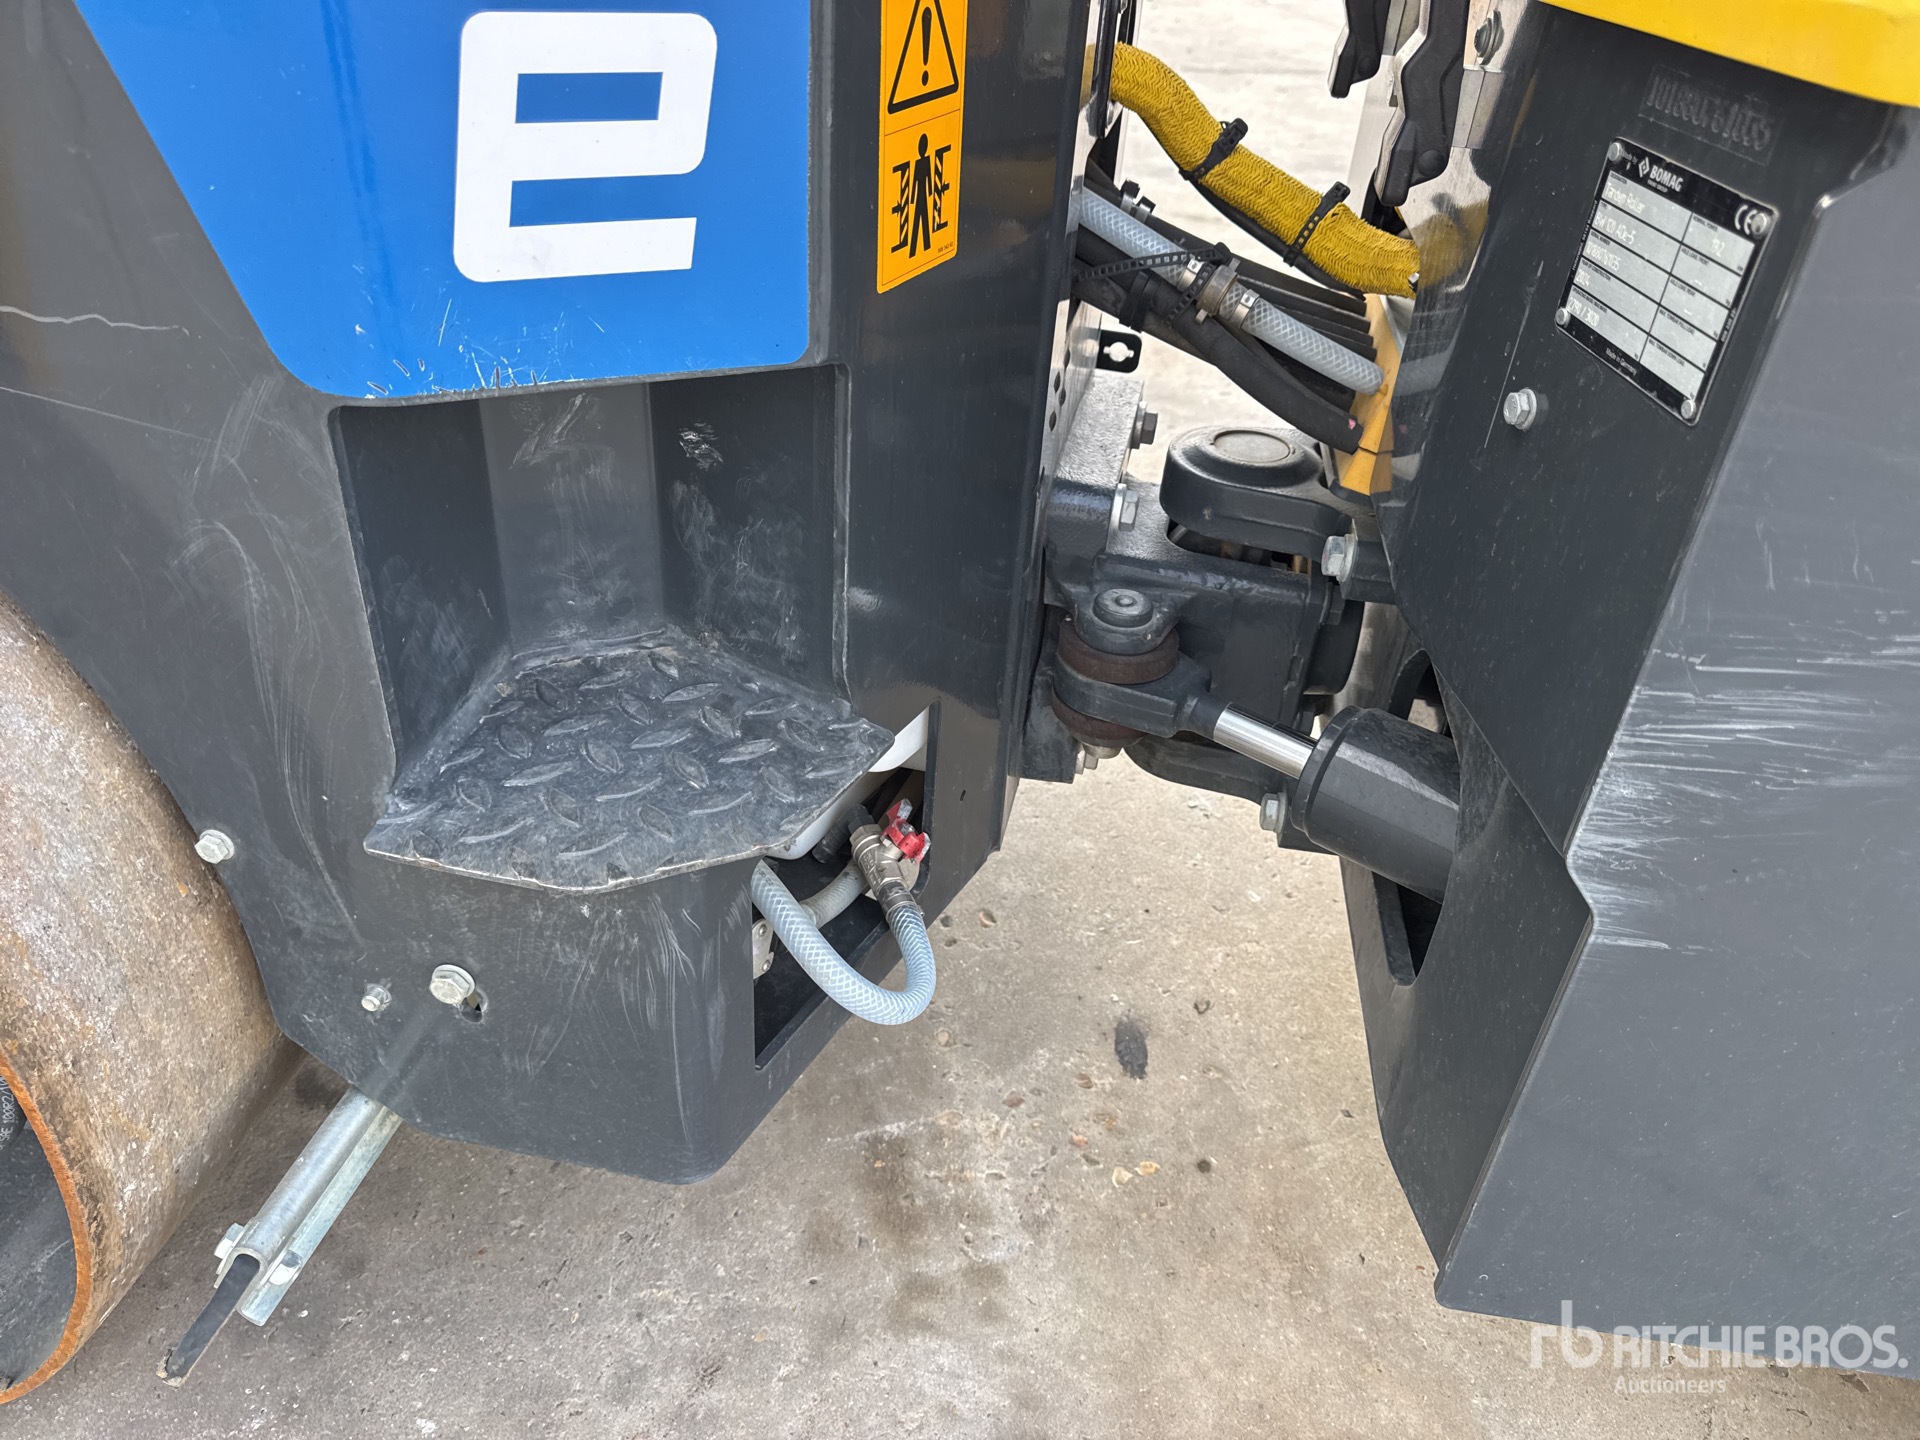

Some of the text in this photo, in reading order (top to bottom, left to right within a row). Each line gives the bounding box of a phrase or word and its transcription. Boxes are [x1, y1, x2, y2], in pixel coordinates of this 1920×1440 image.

[453, 11, 717, 283] e
[1650, 164, 1683, 192] BOMAG
[1626, 192, 1645, 214] Roller
[1619, 358, 1637, 376] Germany
